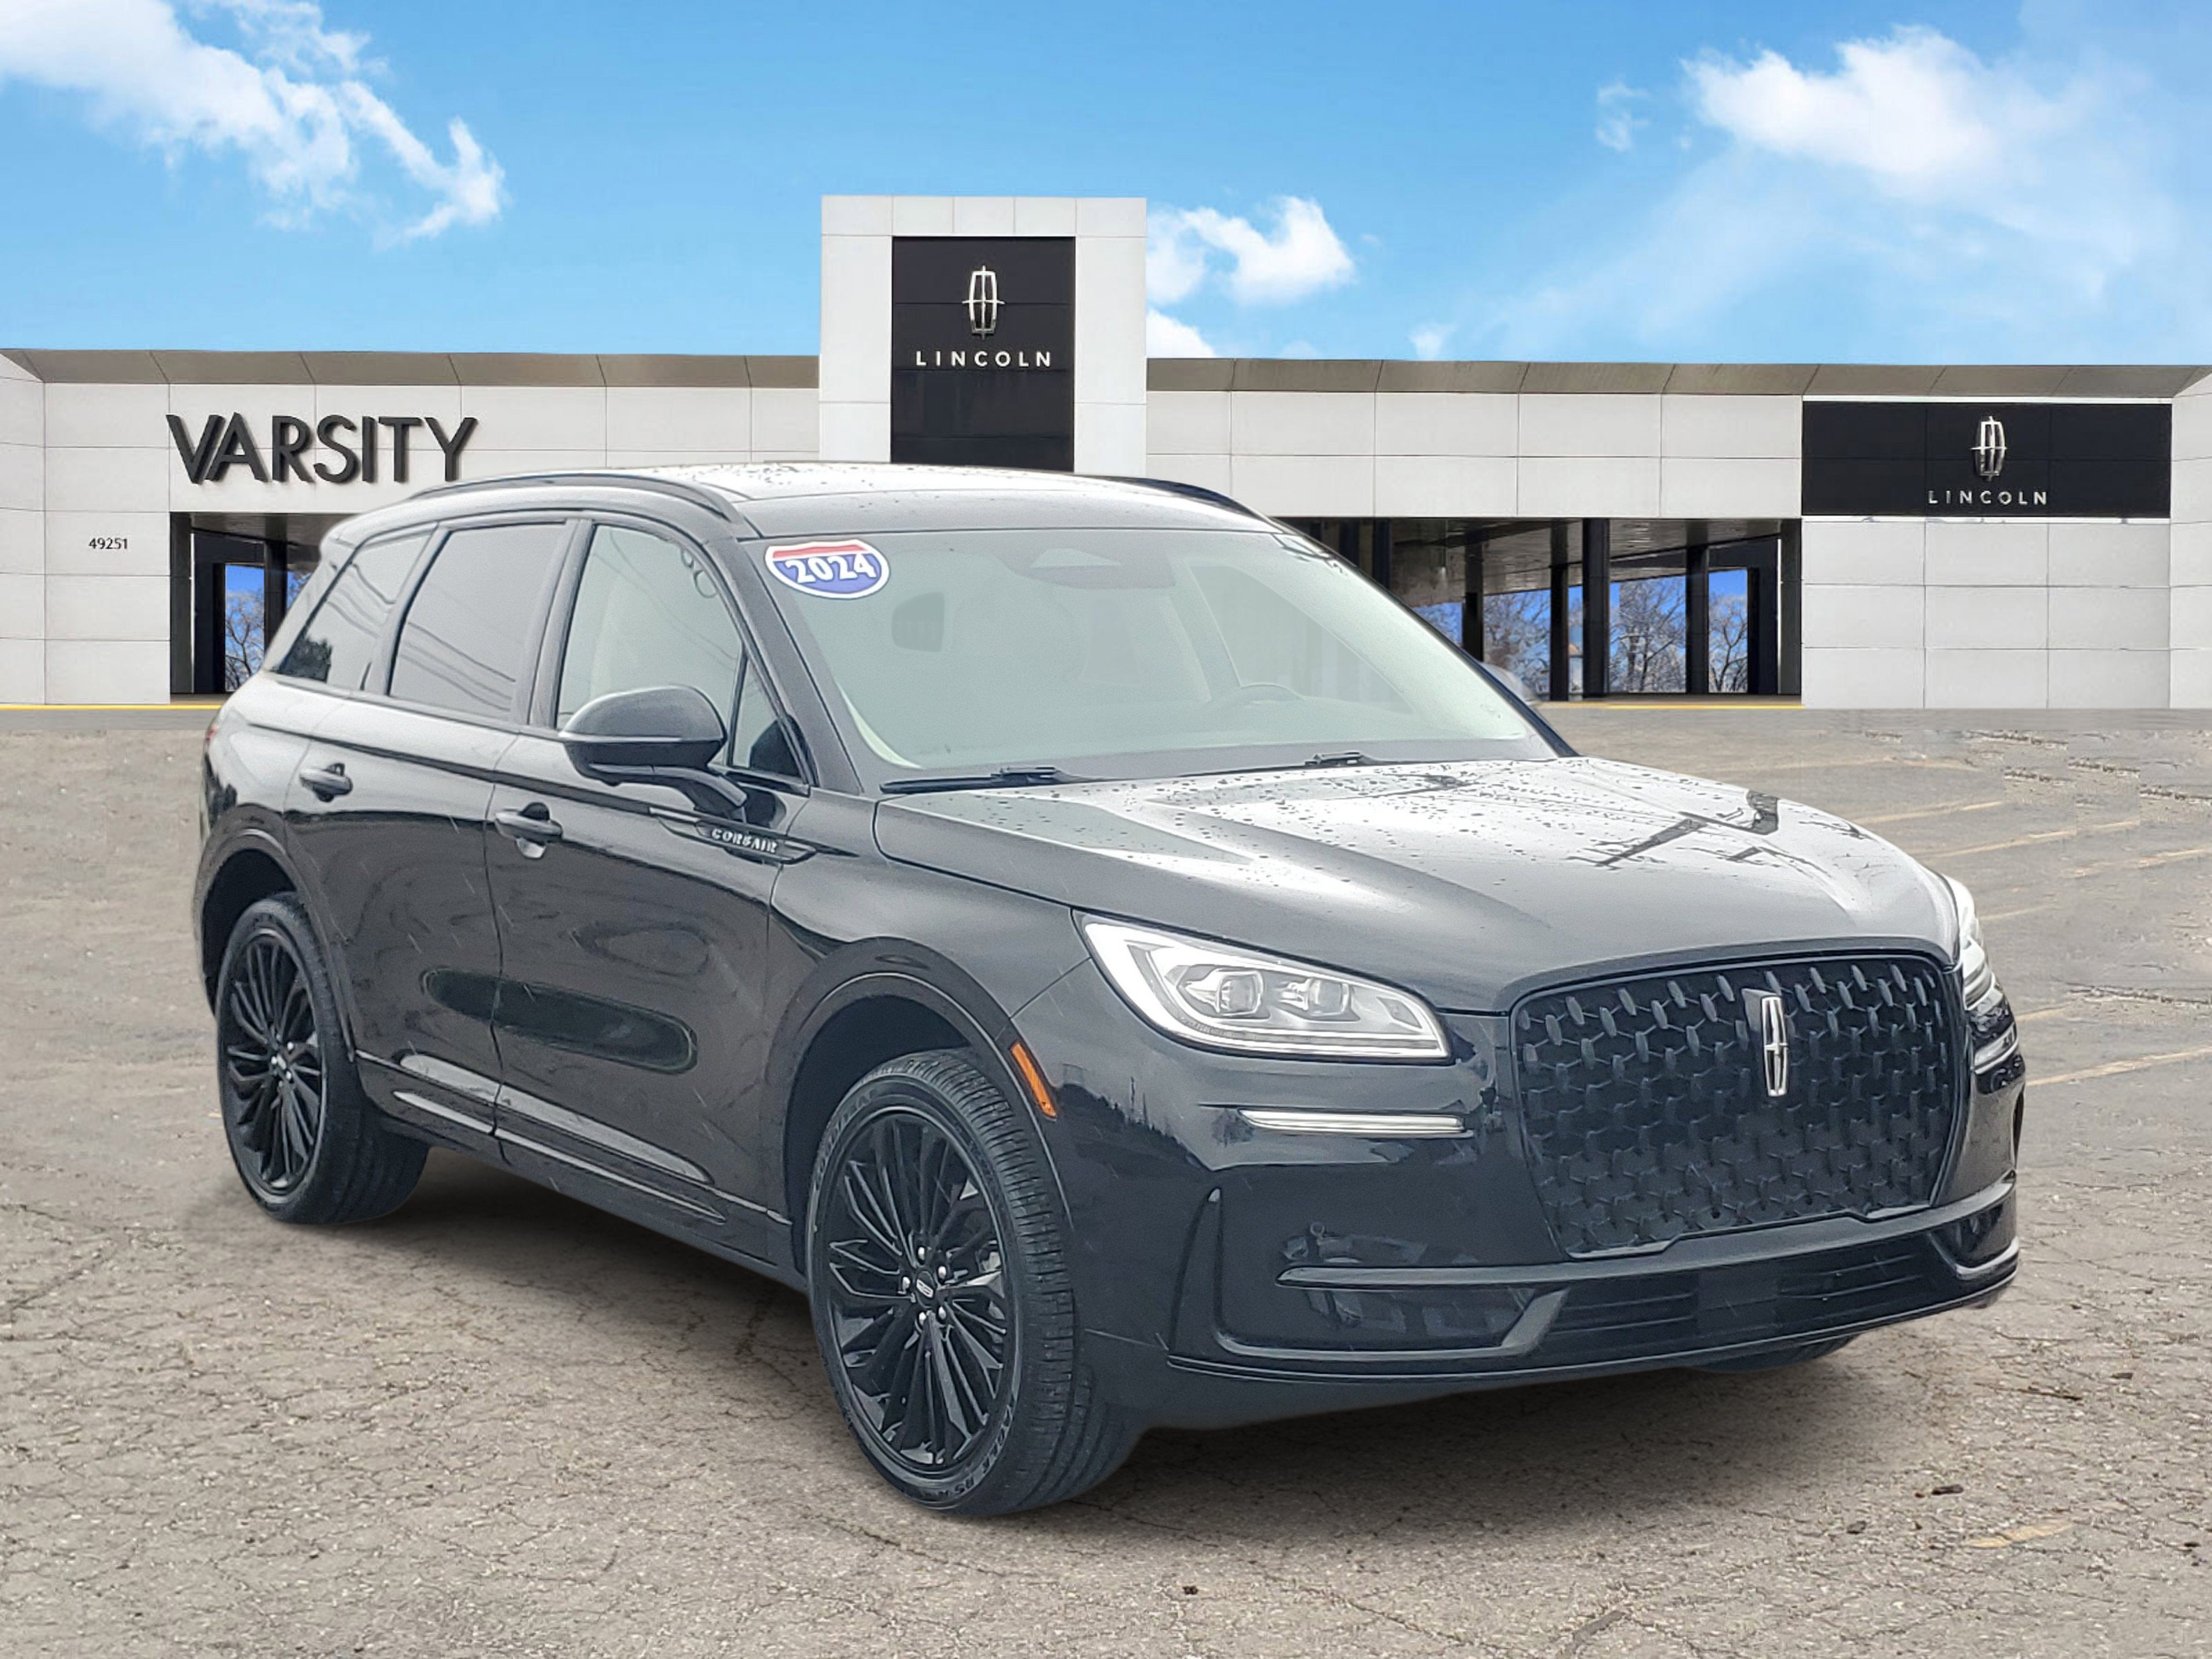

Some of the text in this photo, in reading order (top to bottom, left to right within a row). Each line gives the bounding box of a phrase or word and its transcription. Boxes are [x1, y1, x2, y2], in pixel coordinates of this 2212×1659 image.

[916, 351, 1051, 367] LINCOLN
[166, 412, 478, 484] VARSITY
[1927, 490, 2048, 506] LINCOLN
[88, 537, 129, 550] 49251
[784, 553, 877, 584] 2024
[711, 828, 777, 853] CORSAIR
